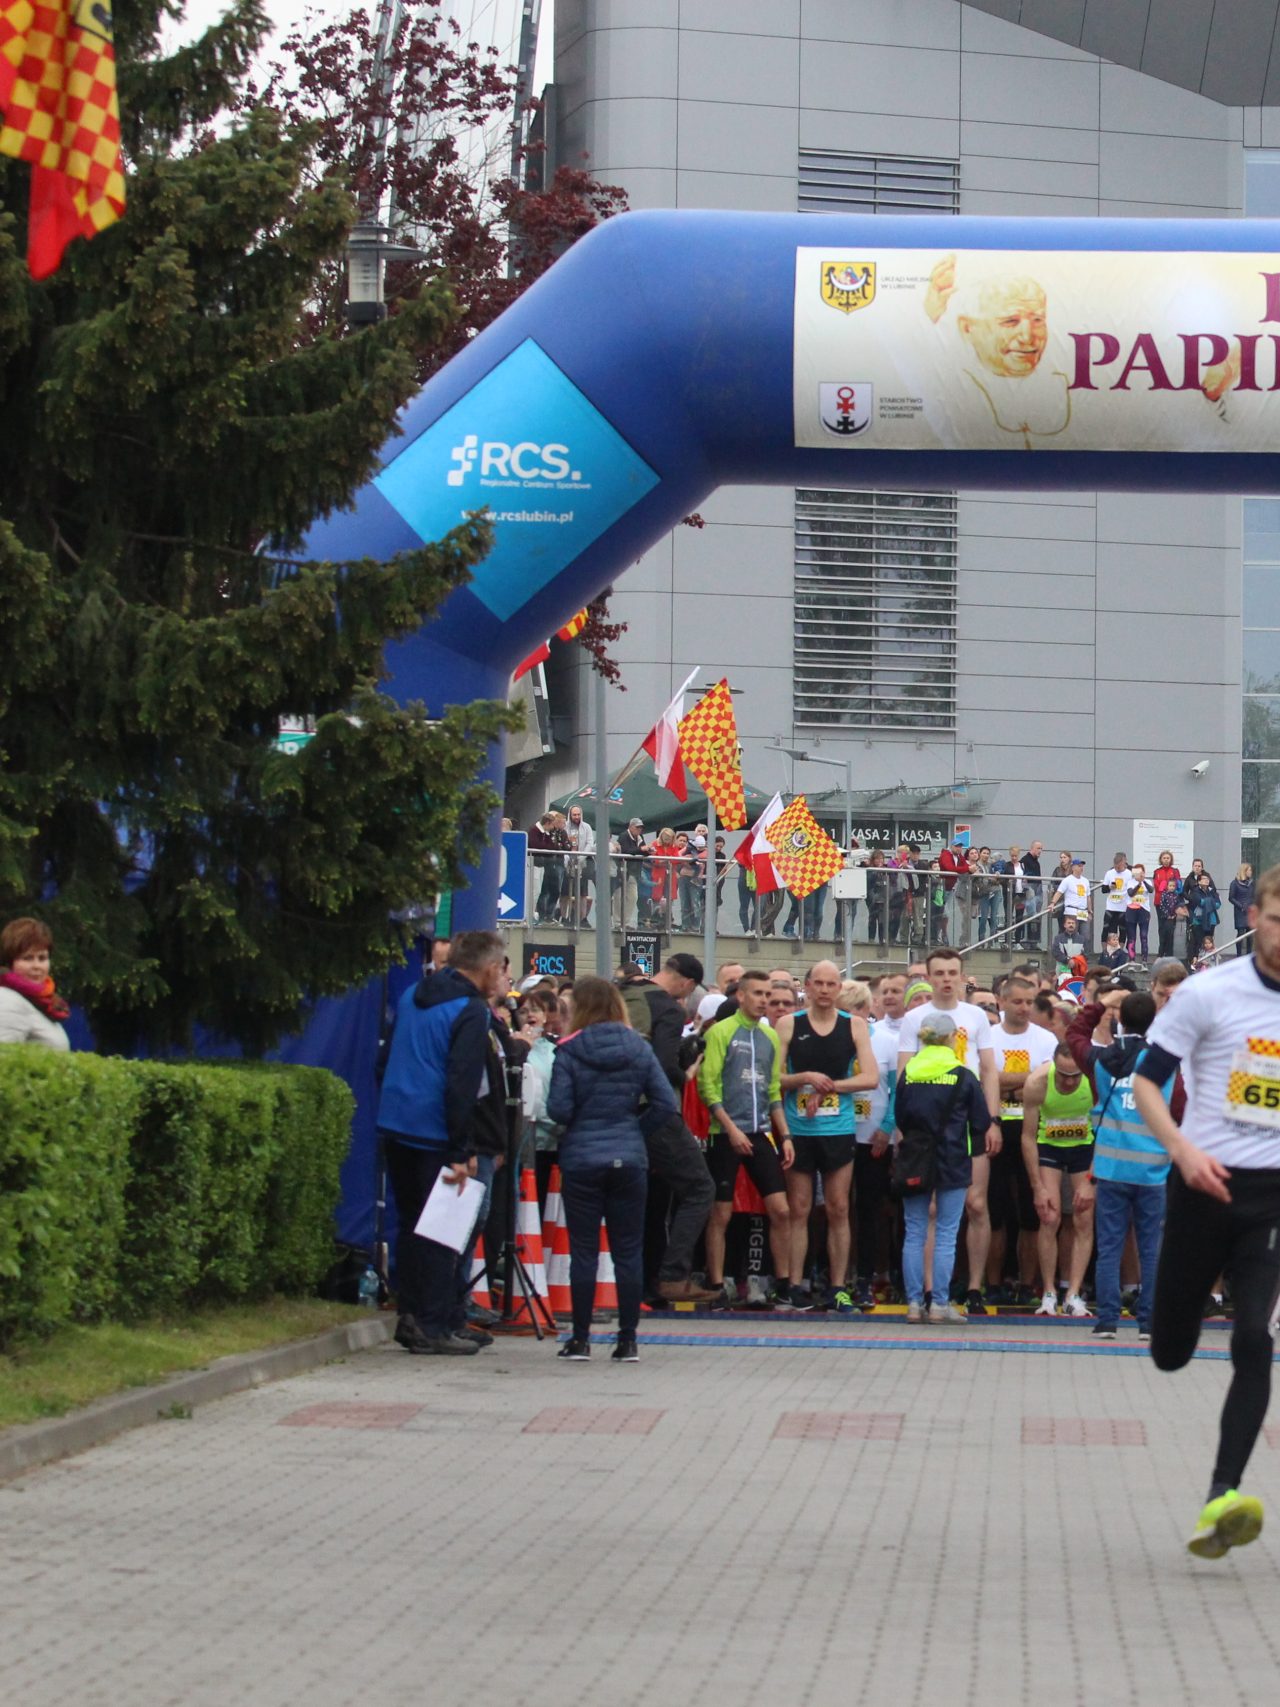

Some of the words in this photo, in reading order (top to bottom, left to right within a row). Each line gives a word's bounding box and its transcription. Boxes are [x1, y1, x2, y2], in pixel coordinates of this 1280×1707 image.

[461, 510, 574, 524] ww.rcslubin.pl
[882, 829, 890, 841] 2
[901, 829, 932, 842] KASA
[935, 830, 942, 842] 3
